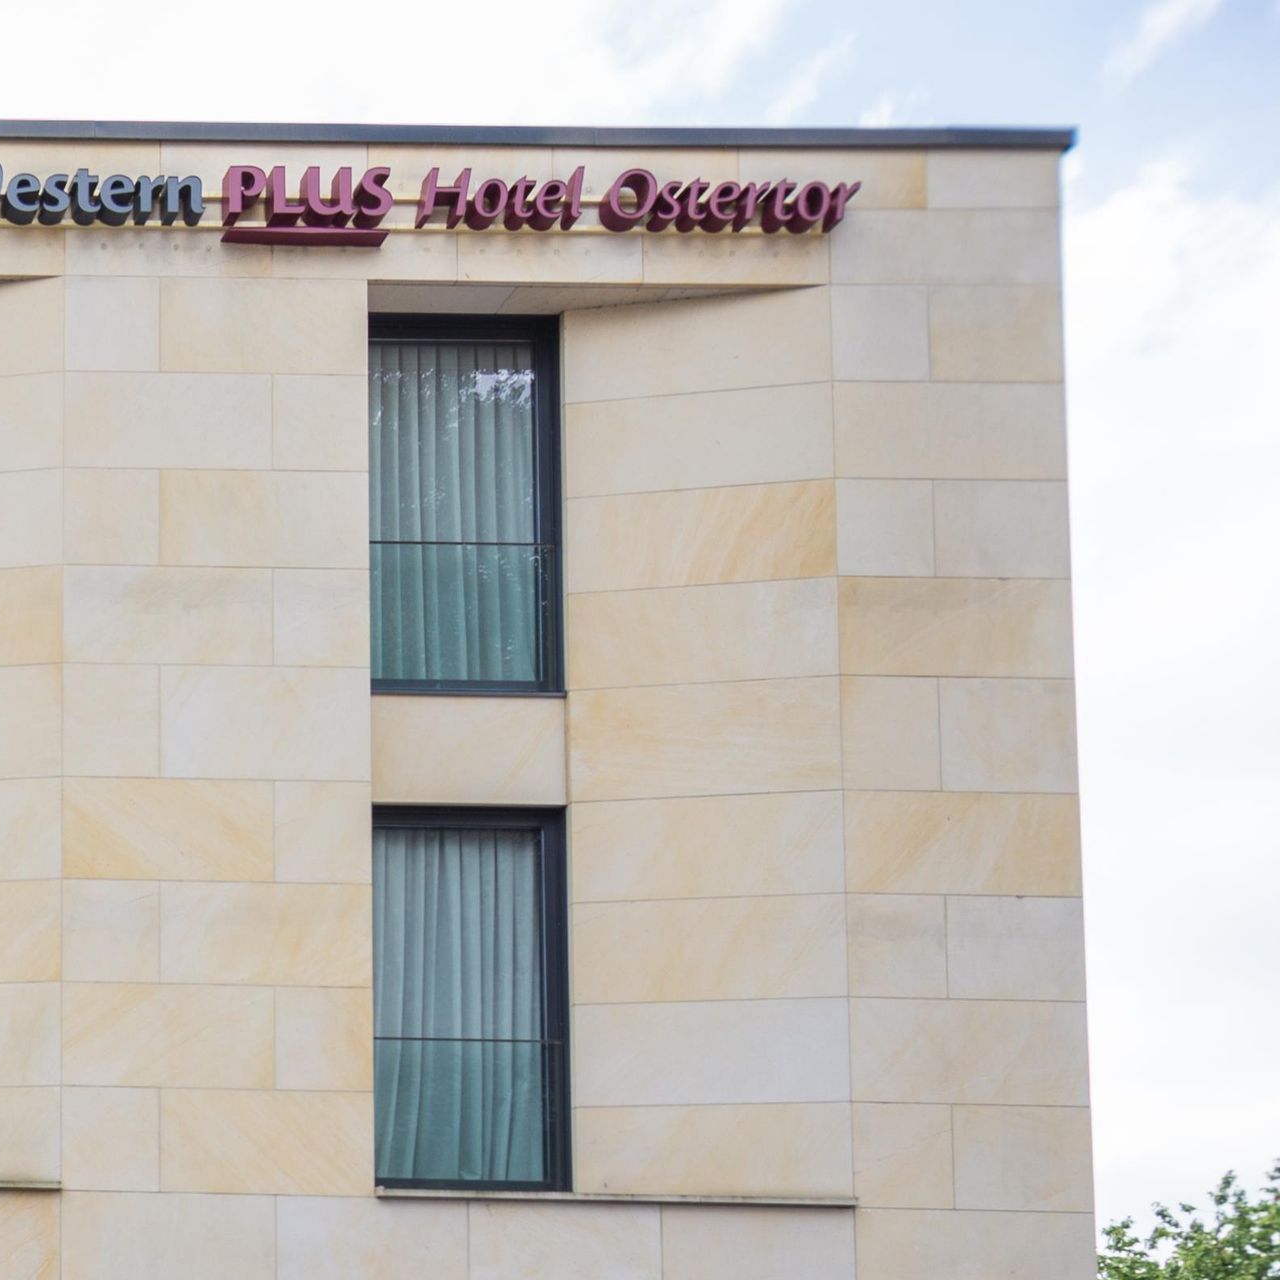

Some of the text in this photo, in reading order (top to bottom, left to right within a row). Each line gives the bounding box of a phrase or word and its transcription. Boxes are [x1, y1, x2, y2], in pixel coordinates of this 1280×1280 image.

[222, 165, 395, 228] PLUS
[414, 165, 586, 231] Hotel
[598, 168, 862, 235] Ostertor
